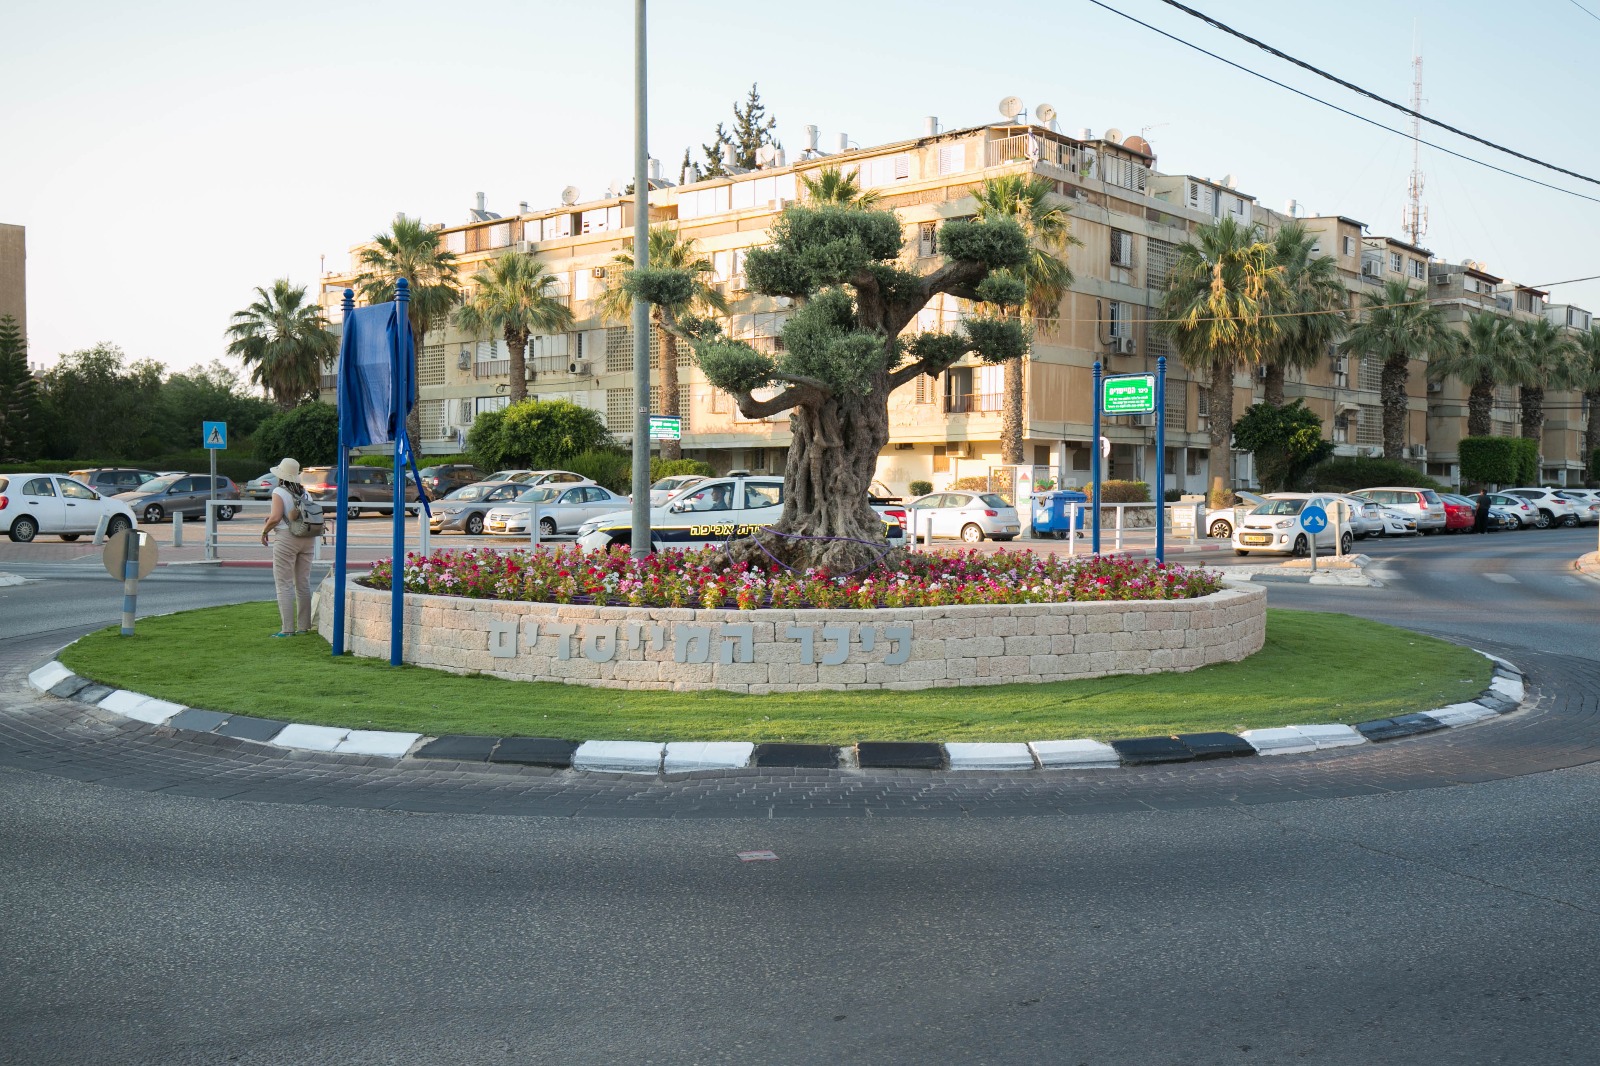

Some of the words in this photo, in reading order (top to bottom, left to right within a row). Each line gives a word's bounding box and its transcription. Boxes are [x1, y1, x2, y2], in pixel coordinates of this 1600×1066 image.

[690, 524, 735, 536] אכיפה
[488, 620, 754, 665] המייסדים
[786, 626, 912, 666] כיכר
